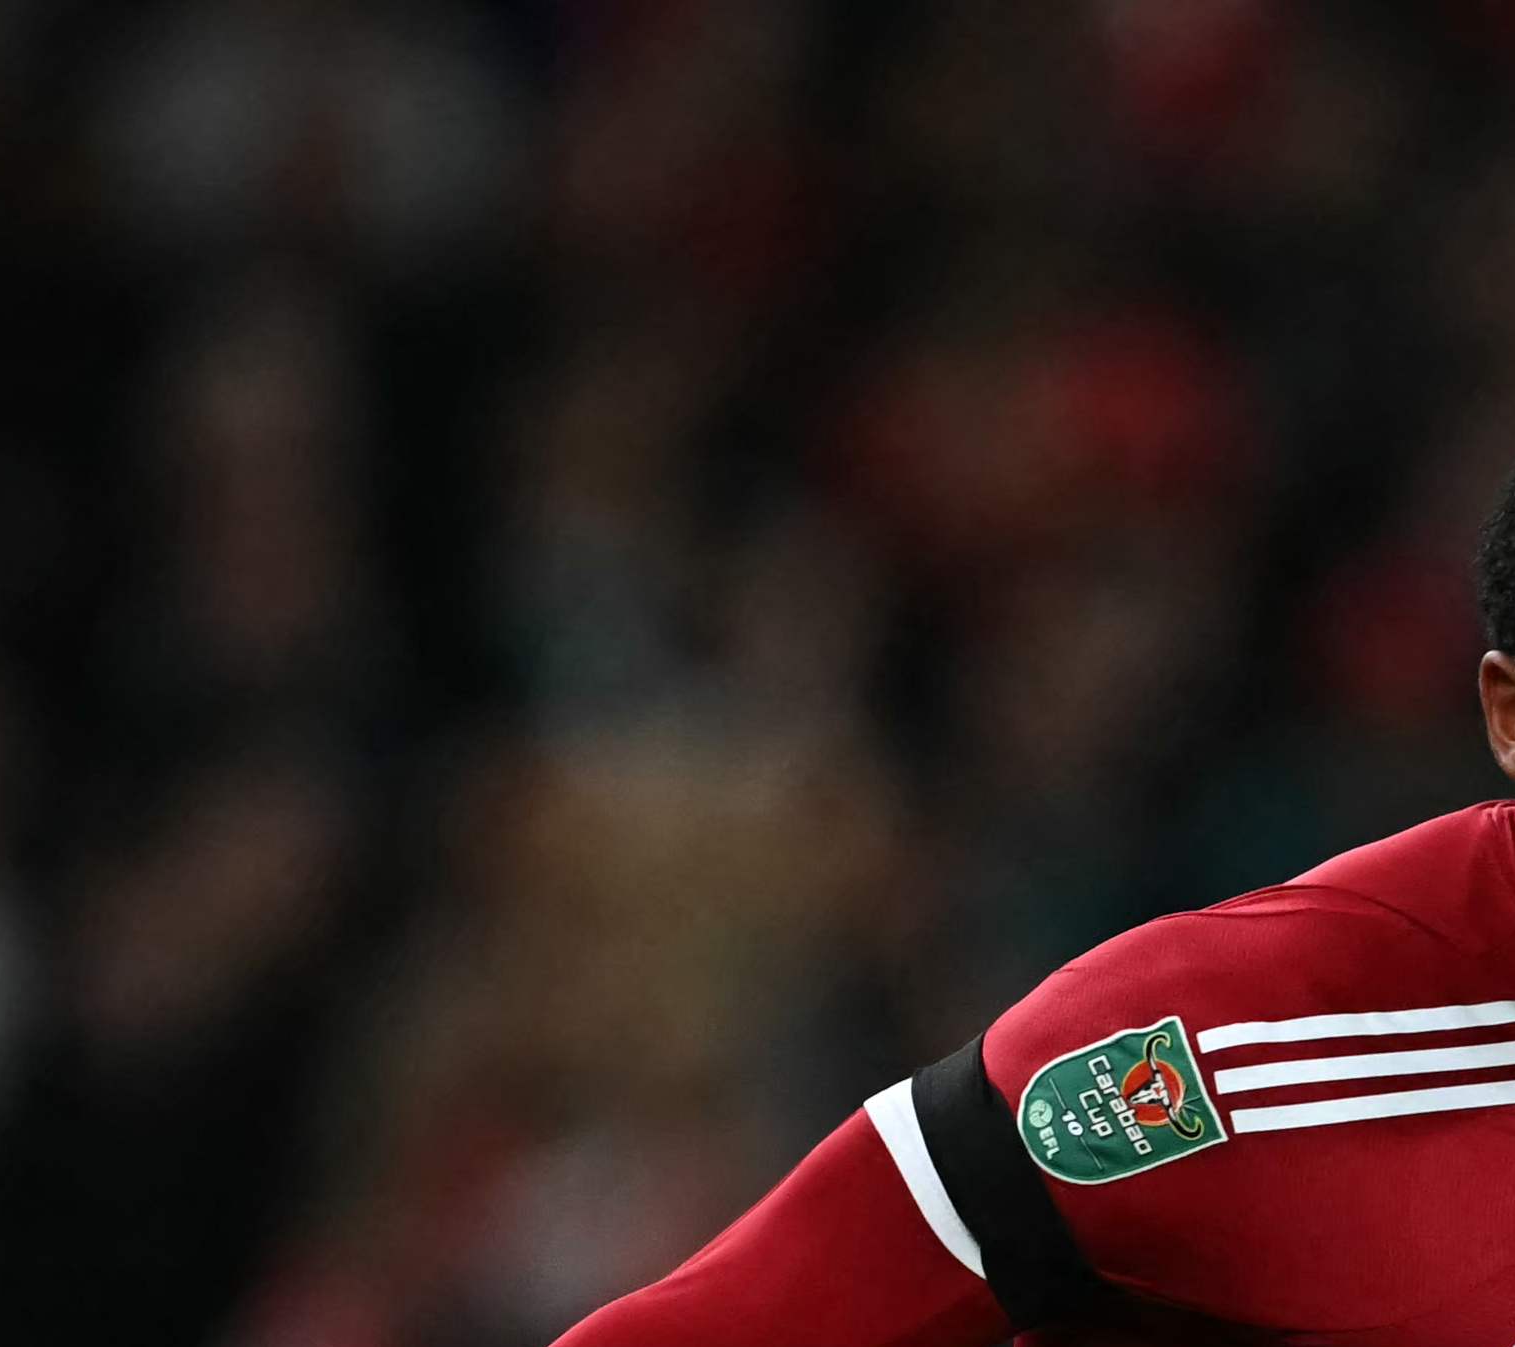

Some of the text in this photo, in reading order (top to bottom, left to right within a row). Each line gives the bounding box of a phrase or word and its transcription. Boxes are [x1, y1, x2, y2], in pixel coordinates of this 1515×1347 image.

[1061, 1110, 1084, 1136] 10
[1078, 1089, 1114, 1137] Cup
[1088, 1055, 1153, 1156] Carabao
[1039, 1126, 1060, 1161] EFL
